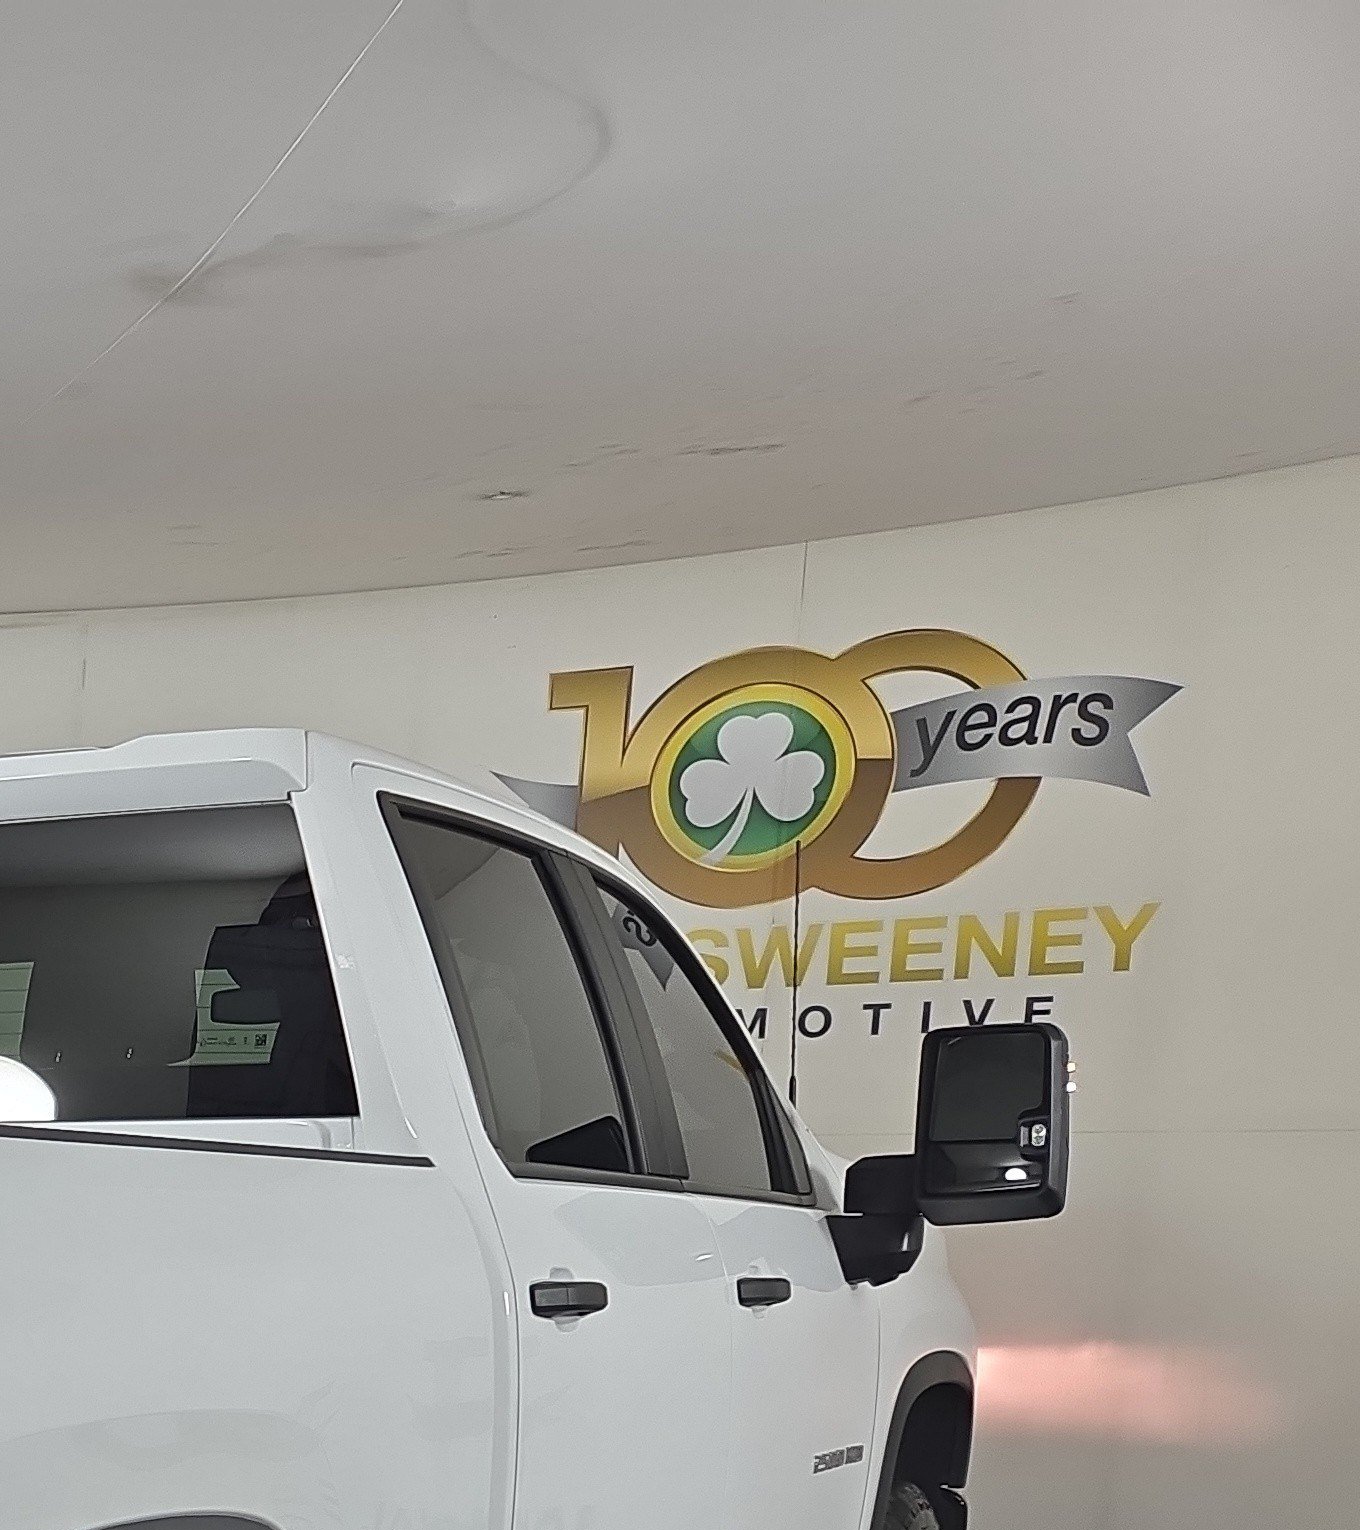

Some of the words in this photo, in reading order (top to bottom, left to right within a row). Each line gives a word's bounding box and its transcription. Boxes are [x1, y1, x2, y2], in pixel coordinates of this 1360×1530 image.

[908, 692, 1114, 779] years
[685, 902, 1162, 991] SWEENEY
[735, 996, 1055, 1040] MOTIVE
